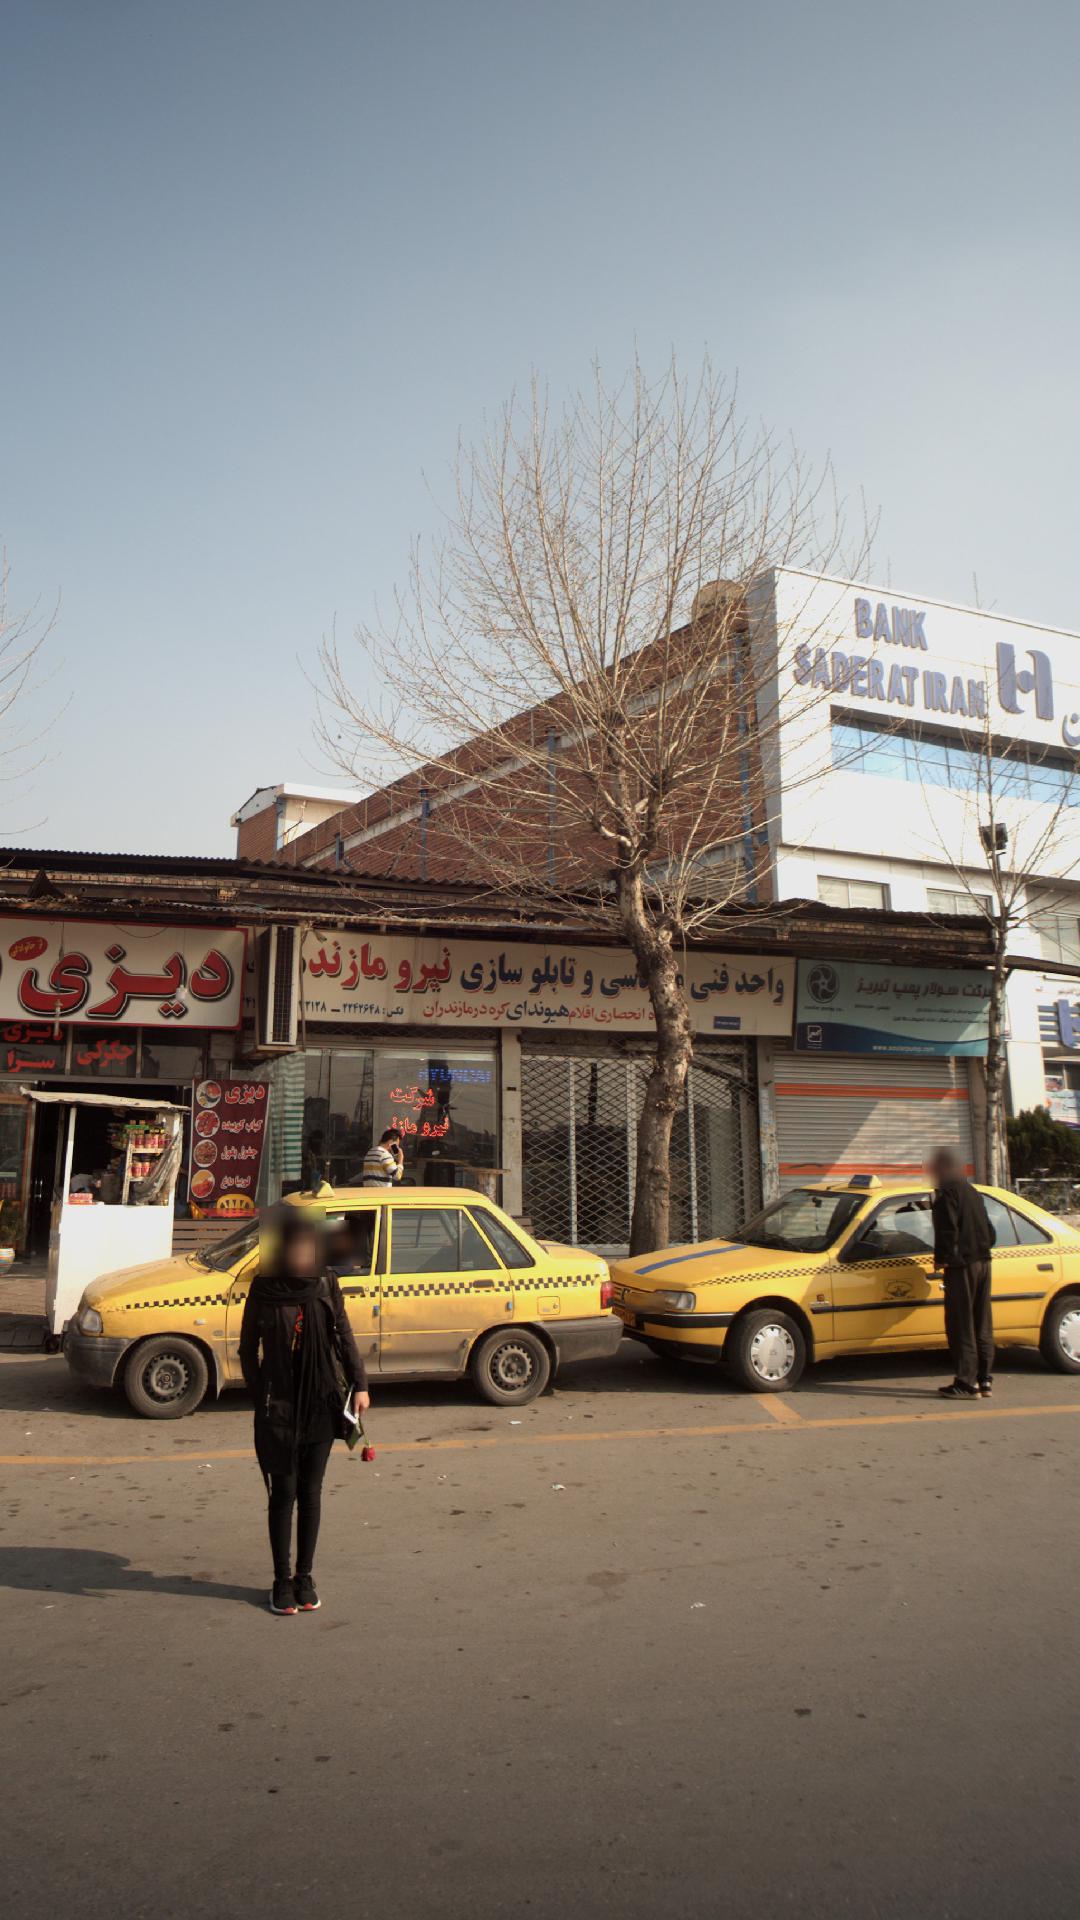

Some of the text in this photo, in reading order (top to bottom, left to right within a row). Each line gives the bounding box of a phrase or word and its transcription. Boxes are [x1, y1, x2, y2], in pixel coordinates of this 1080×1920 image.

[854, 597, 928, 650] BANK
[793, 642, 986, 719] SADERAT IRAN
[18, 943, 235, 1020] دیزی
[308, 941, 389, 990] مازند
[393, 946, 451, 992] نیرو
[460, 953, 523, 993] سازی
[528, 954, 577, 994] تابلو
[580, 968, 593, 997] و
[690, 962, 729, 1001] فنی
[735, 966, 784, 1003] واحد
[489, 1002, 511, 1020] کره
[569, 1005, 595, 1024] اقلام
[595, 1007, 645, 1024] انحصاری
[7, 1050, 56, 1073] سرا
[225, 1084, 265, 1105] دیزی
